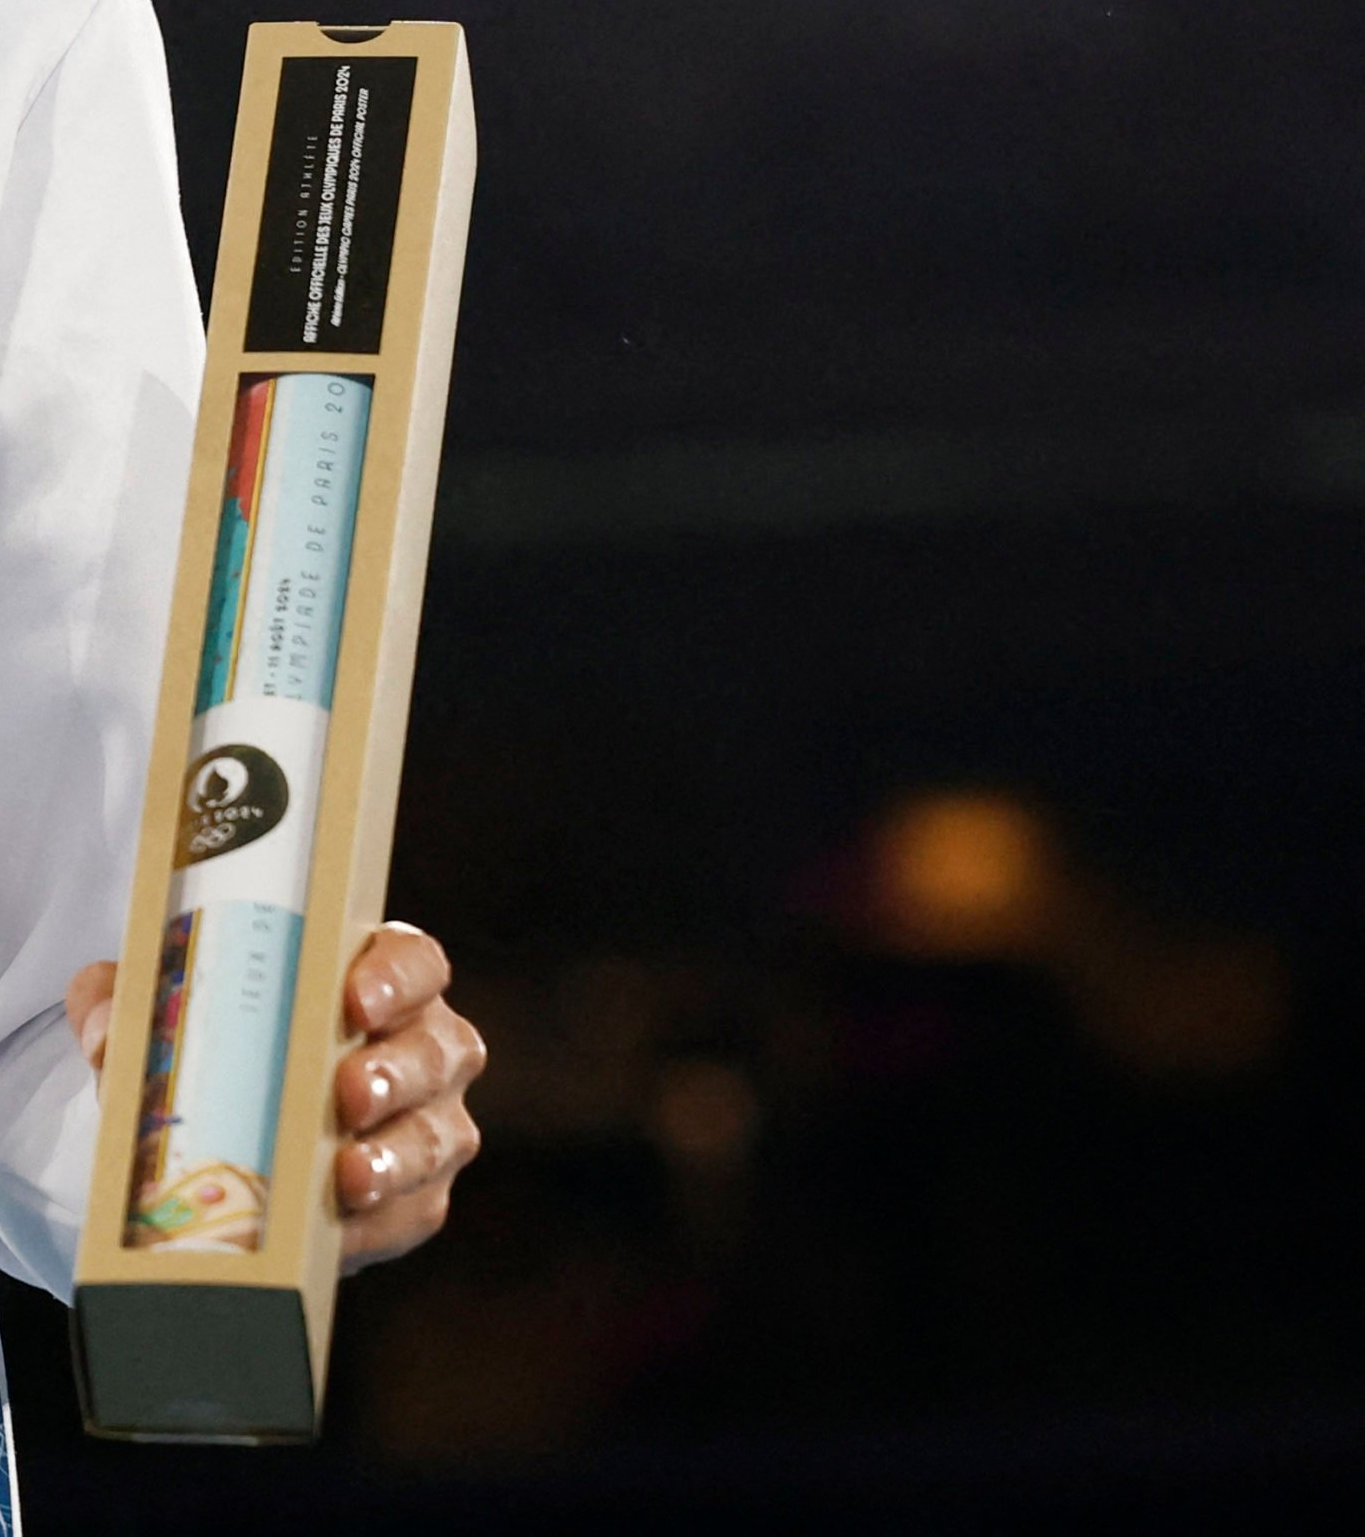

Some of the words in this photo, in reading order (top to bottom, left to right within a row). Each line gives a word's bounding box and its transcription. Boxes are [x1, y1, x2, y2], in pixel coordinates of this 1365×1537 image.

[334, 65, 350, 93] 2024
[331, 94, 348, 122] PARIS
[356, 88, 369, 121] POSTER
[329, 123, 344, 136] DE
[351, 122, 366, 158] OFFICIAL
[321, 137, 342, 202] OLYMPIQUES
[348, 158, 361, 182] 2024
[345, 181, 358, 207] PARIS
[317, 202, 334, 225] JEUX
[341, 206, 355, 237] GAMES
[315, 225, 331, 245] DES
[336, 236, 351, 275] OLYMPIC
[308, 245, 329, 301] OFFICIELLE
[302, 301, 322, 343] AFFICHE
[324, 382, 346, 413] 20
[311, 431, 340, 507] PARIS
[305, 524, 326, 552] DE
[284, 570, 321, 702] LYMPIADE
